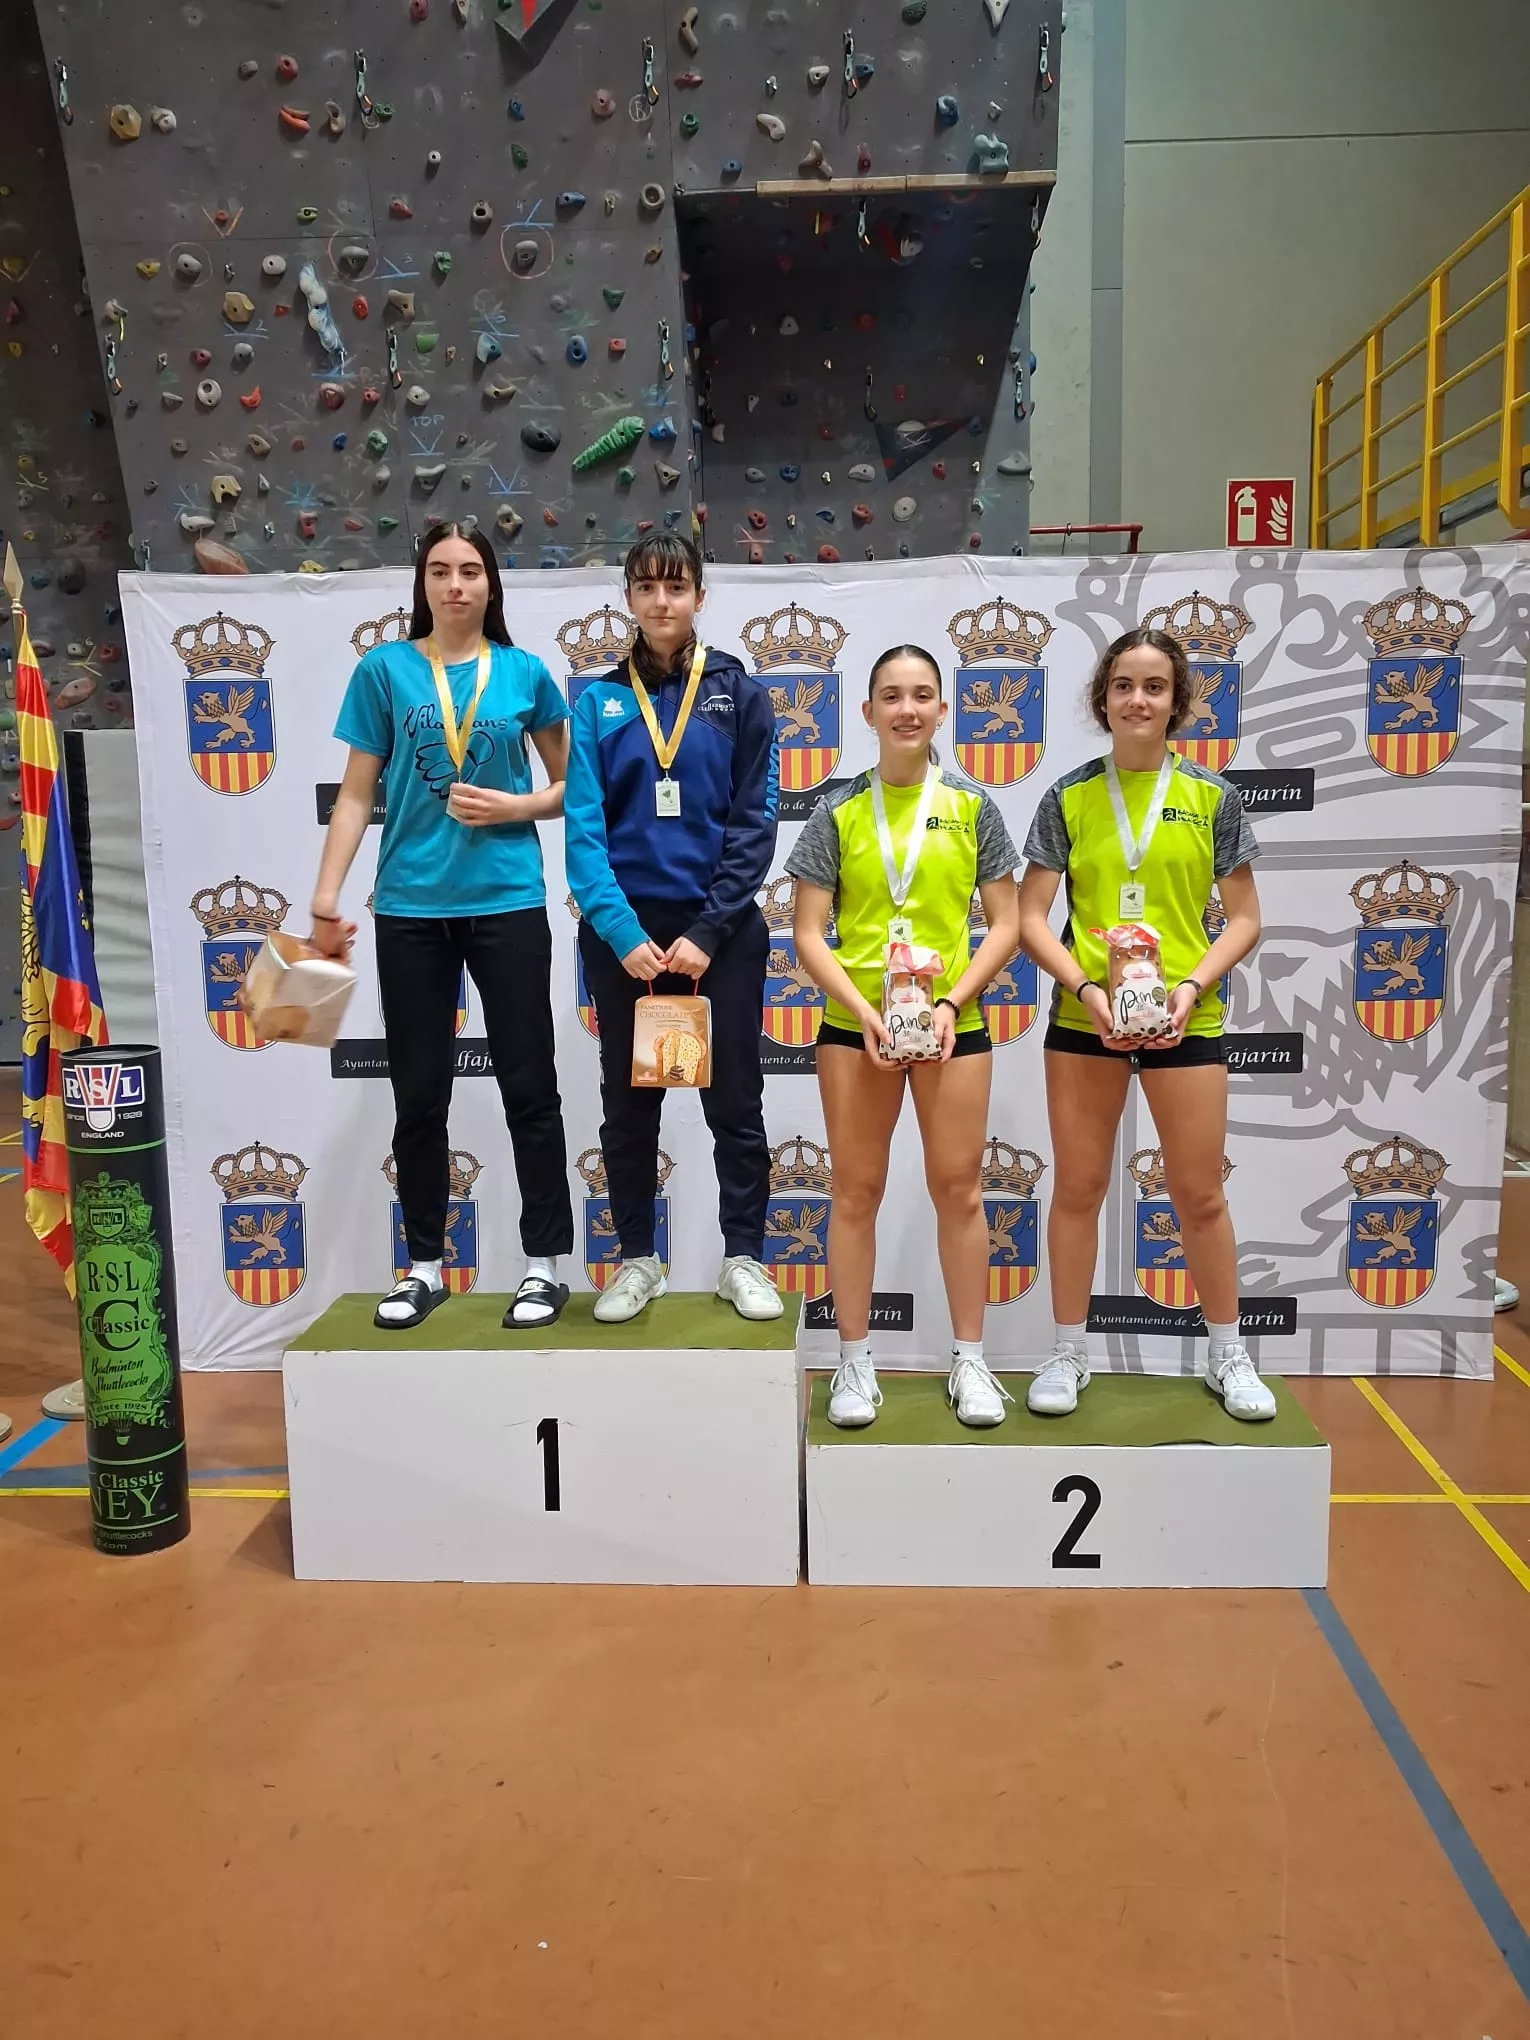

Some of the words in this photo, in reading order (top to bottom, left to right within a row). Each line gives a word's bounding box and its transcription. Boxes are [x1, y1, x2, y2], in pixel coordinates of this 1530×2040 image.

[792, 800, 806, 810] de
[793, 1054, 806, 1064] de
[1225, 1046, 1291, 1069] ajarín
[64, 1076, 141, 1099] RSL
[81, 1131, 125, 1139] ENGLAND
[522, 1281, 545, 1291] NIKE
[85, 1315, 150, 1334] Classic
[1089, 1314, 1171, 1327] Ayuntamiento
[1174, 1316, 1188, 1327] de
[91, 1356, 144, 1376] Badminton
[96, 1371, 149, 1393] Shuttlecocks
[536, 1418, 561, 1512] 1
[99, 1470, 164, 1489] Classic
[1052, 1475, 1101, 1568] 2
